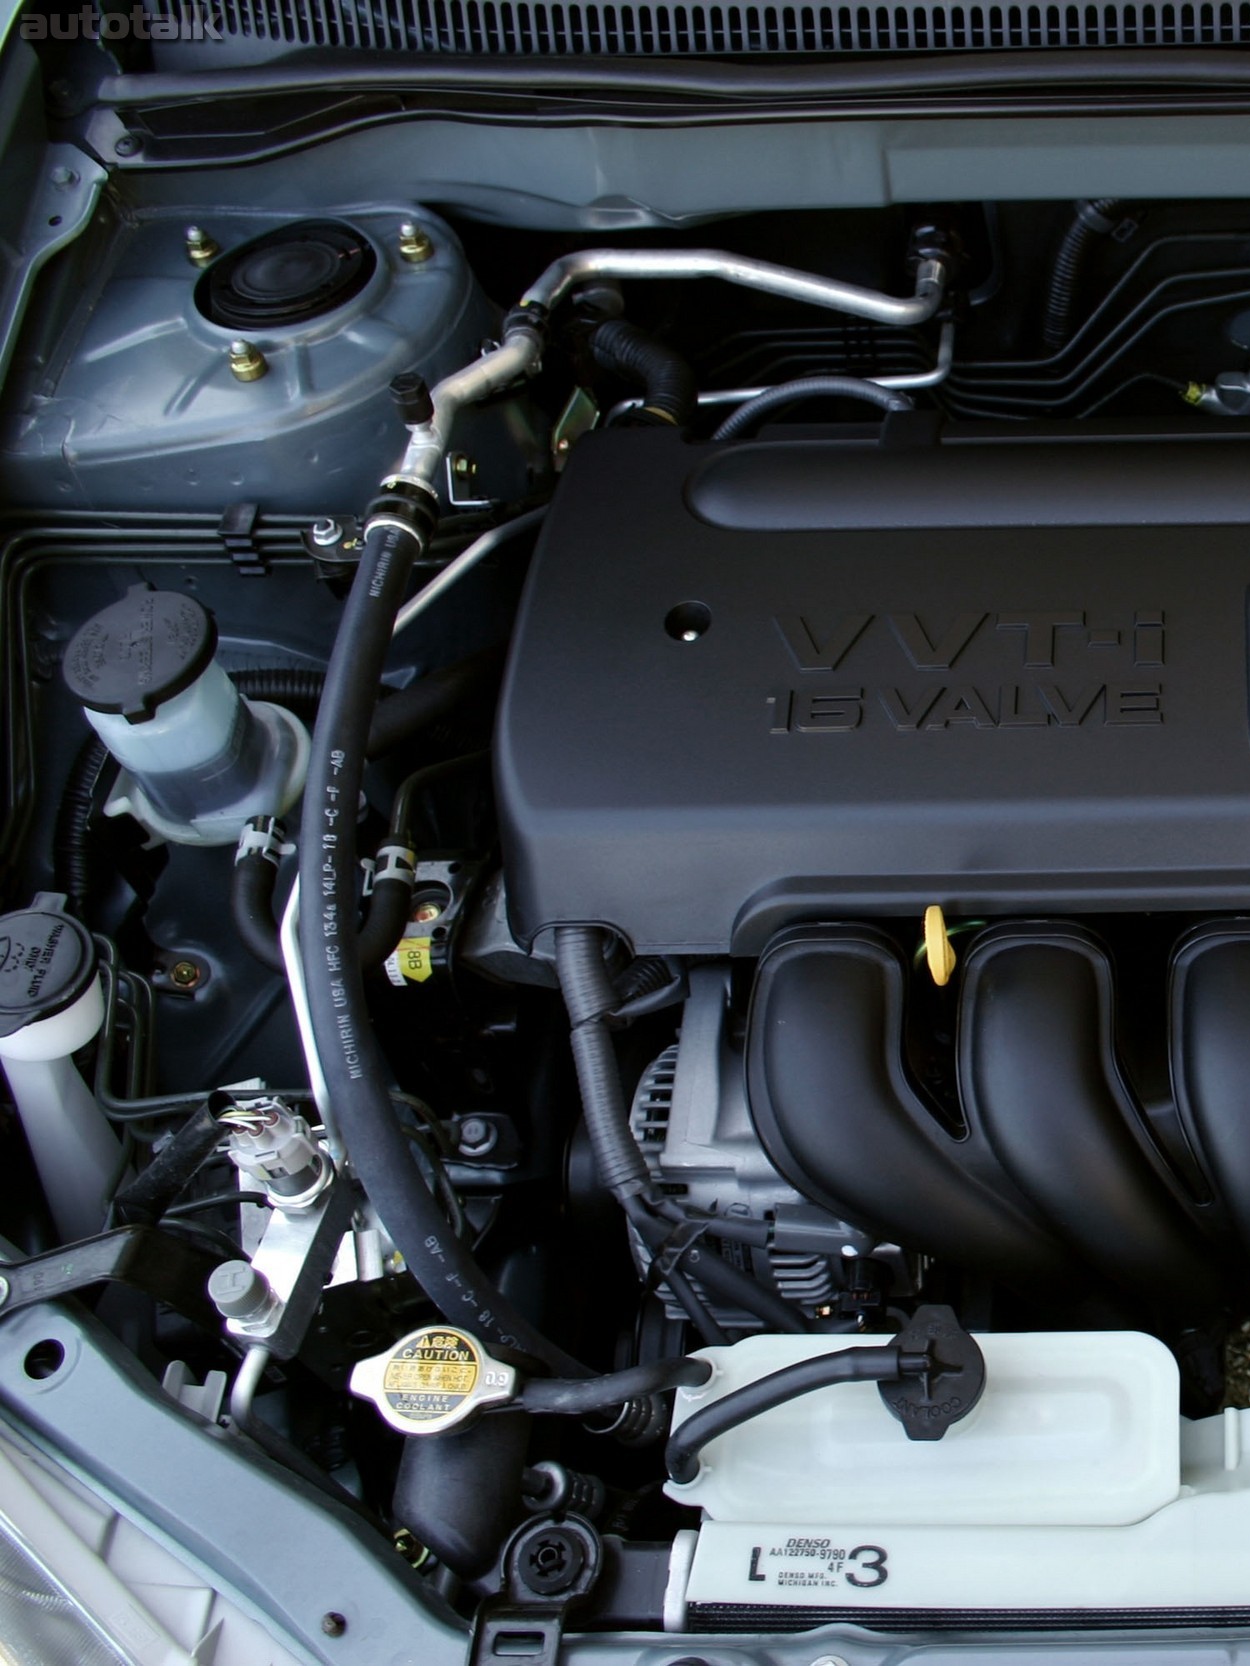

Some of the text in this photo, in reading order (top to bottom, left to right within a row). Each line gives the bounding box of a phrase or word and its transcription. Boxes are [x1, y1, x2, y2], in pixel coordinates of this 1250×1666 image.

[772, 610, 1166, 672] VVT-i
[766, 683, 1163, 734] 16 VALVE
[326, 945, 342, 973] HFC
[407, 950, 422, 970] 8B
[27, 968, 47, 998] FLUID
[331, 977, 348, 1008] USA
[337, 1014, 364, 1080] NICHIRIN
[402, 1348, 469, 1360] CAUTION
[485, 1371, 509, 1386] 0.9
[396, 1402, 451, 1411] COOLANT
[401, 1394, 449, 1402] ENGINE
[786, 1538, 831, 1548] DENSO
[748, 1546, 766, 1582] L
[845, 1545, 889, 1588] 3
